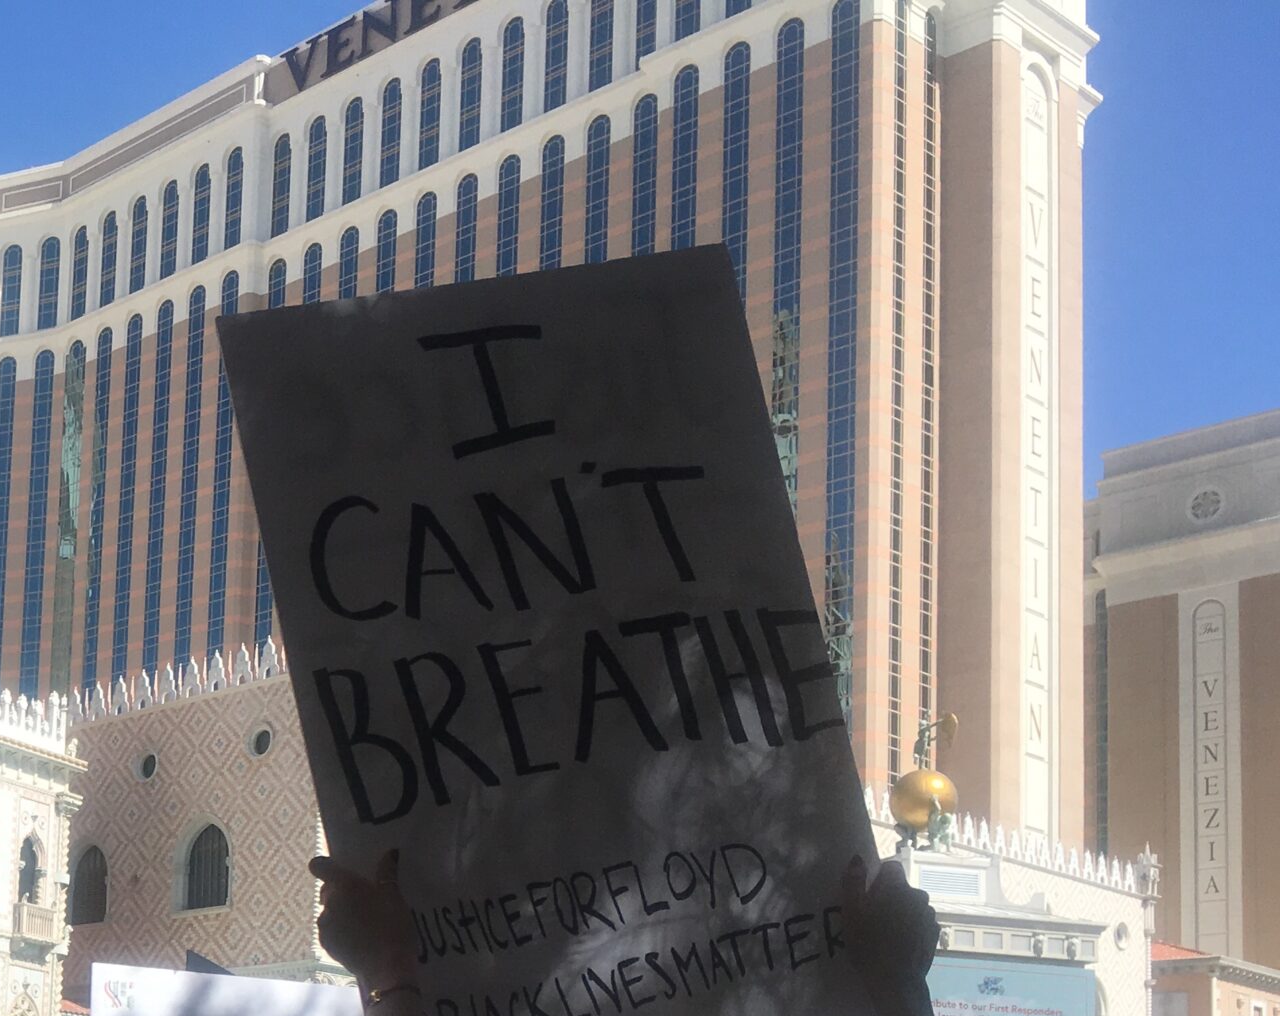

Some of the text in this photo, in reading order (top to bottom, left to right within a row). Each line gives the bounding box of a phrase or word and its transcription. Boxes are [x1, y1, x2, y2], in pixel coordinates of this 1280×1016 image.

[280, 0, 479, 91] VENE
[417, 325, 555, 460] I
[310, 462, 704, 621] CAN'T
[1027, 201, 1044, 744] VENETIAN
[312, 607, 845, 825] BREATHE
[1202, 679, 1221, 895] VENEZIA
[931, 1000, 956, 1010] ribute
[959, 1002, 969, 1011] to
[971, 1004, 987, 1012] our
[989, 1003, 1009, 1014] First
